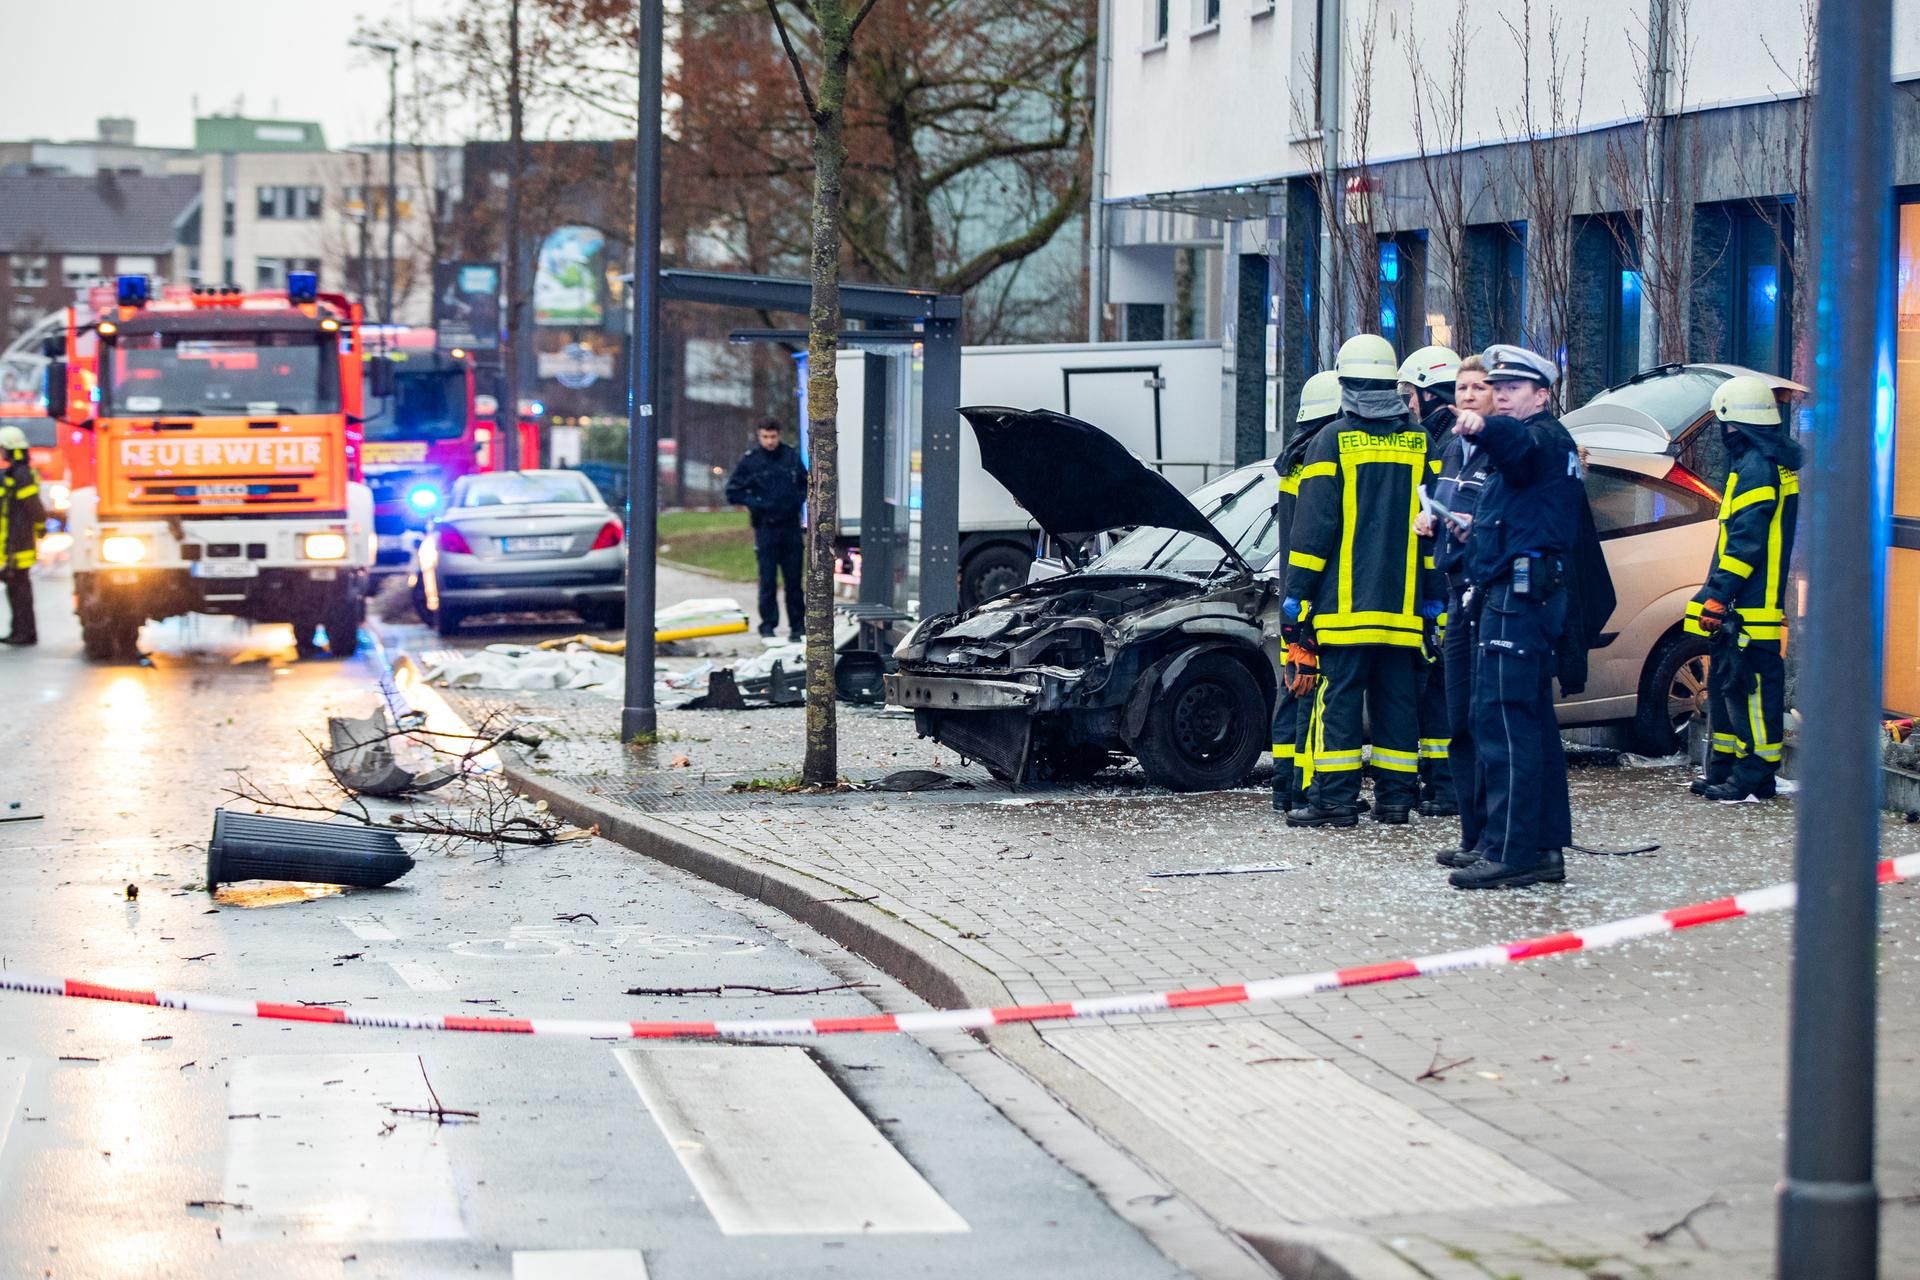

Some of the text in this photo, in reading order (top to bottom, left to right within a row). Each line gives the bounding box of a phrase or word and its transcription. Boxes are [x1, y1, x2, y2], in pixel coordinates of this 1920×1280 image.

[1341, 434, 1424, 450] FEUERWEHR
[121, 438, 322, 466] FEUERWEHR
[1490, 639, 1513, 649] POLIZEI
